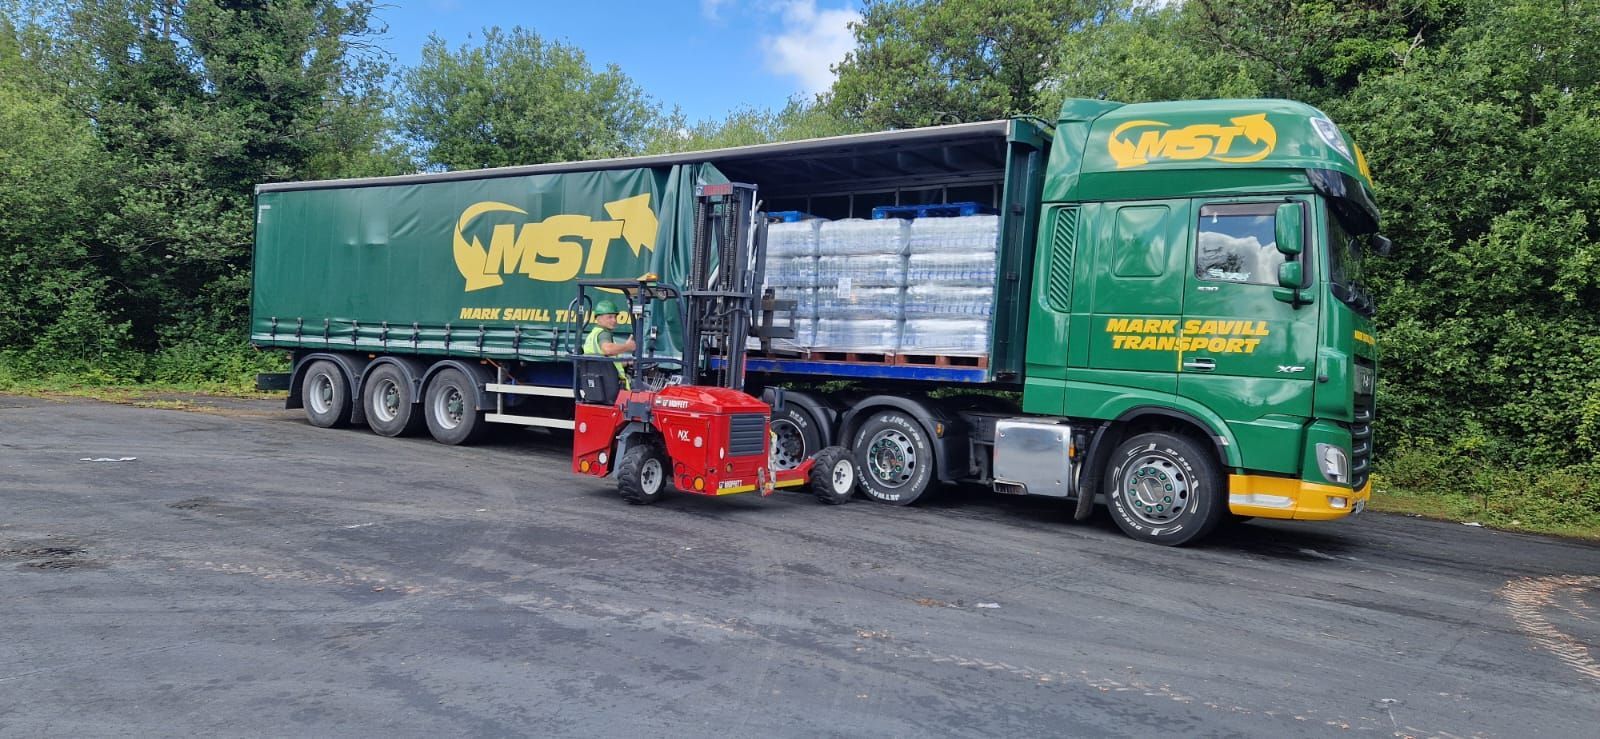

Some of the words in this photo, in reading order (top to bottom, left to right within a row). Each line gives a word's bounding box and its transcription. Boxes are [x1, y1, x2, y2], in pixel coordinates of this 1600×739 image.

[1131, 124, 1246, 160] MST
[483, 214, 625, 282] MST
[459, 307, 500, 321] MARK
[502, 307, 551, 322] SAVILL
[1106, 319, 1179, 334] MARK
[1181, 319, 1270, 336] SAVILL
[1112, 335, 1261, 353] TRANSPORT
[1277, 364, 1306, 373] XF
